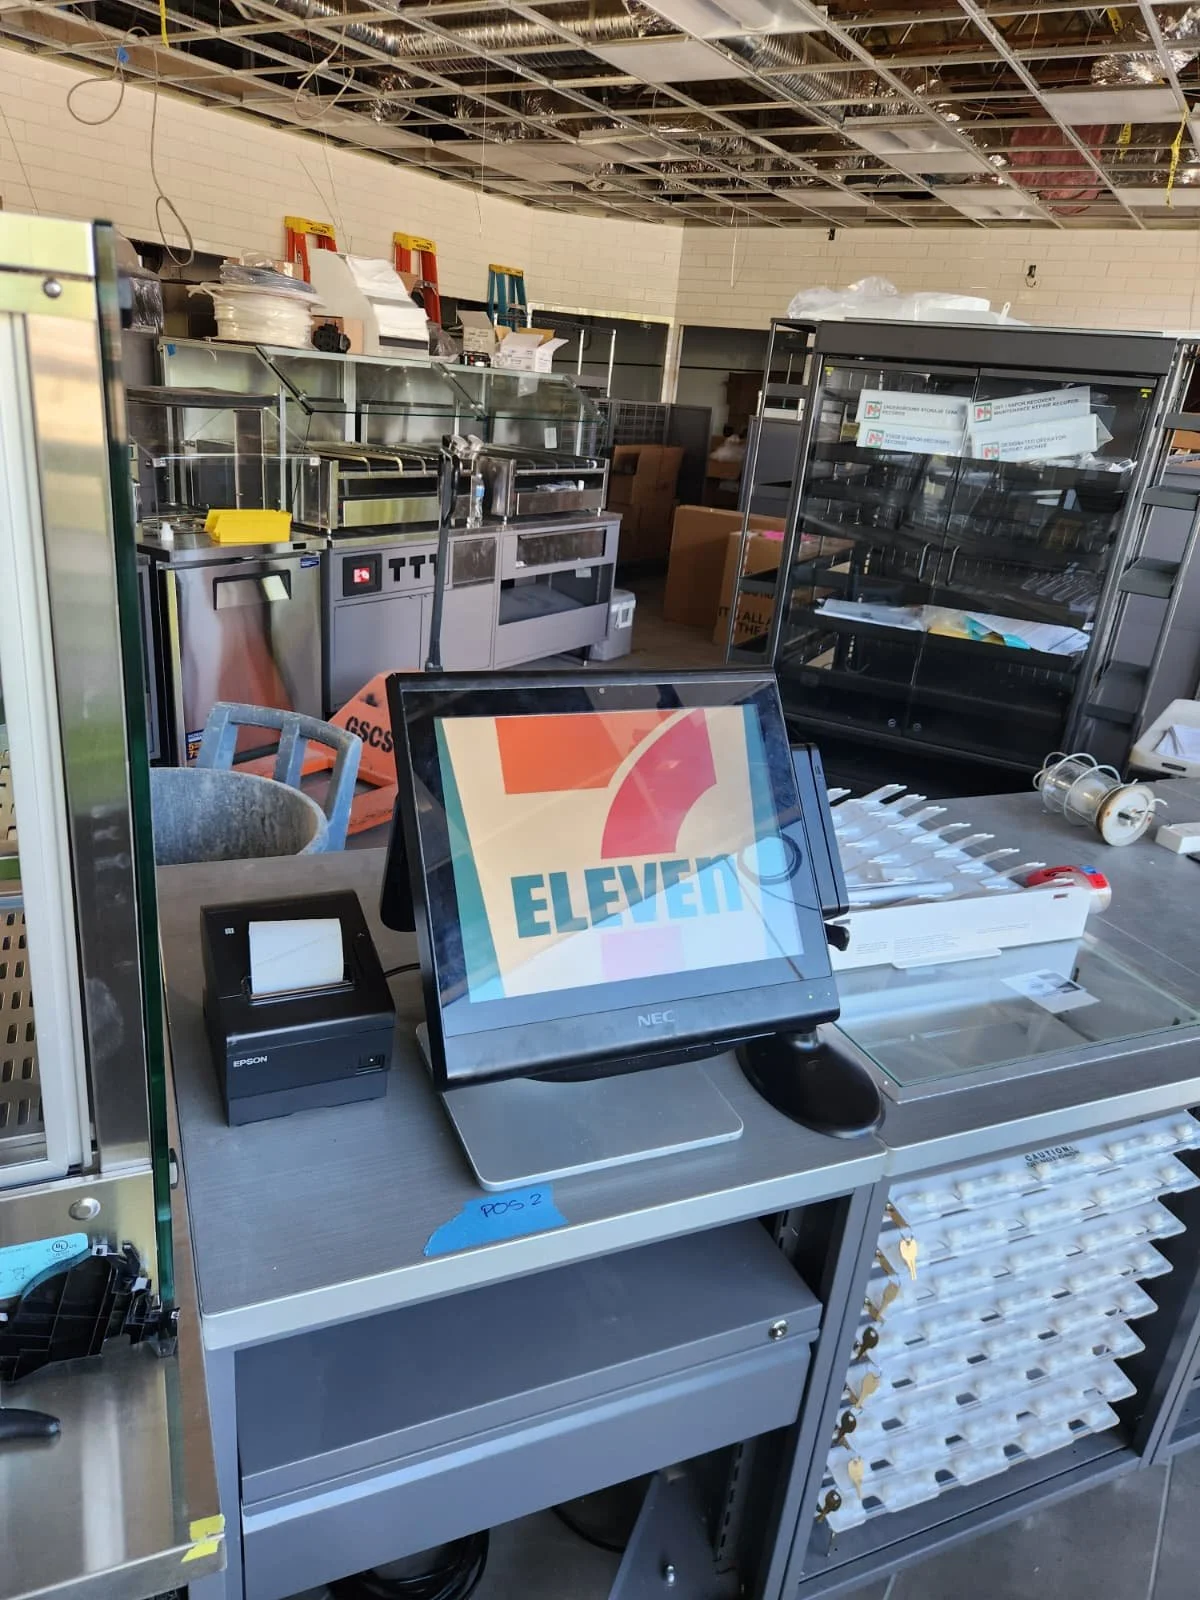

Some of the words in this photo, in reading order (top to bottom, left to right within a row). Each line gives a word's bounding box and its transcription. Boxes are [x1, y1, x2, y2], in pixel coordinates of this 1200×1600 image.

[738, 621, 760, 635] THE
[345, 715, 393, 753] GSCS
[637, 1010, 676, 1027] NEC
[233, 1056, 268, 1068] EPSON
[480, 1199, 525, 1218] POS
[529, 1193, 542, 1206] 2
